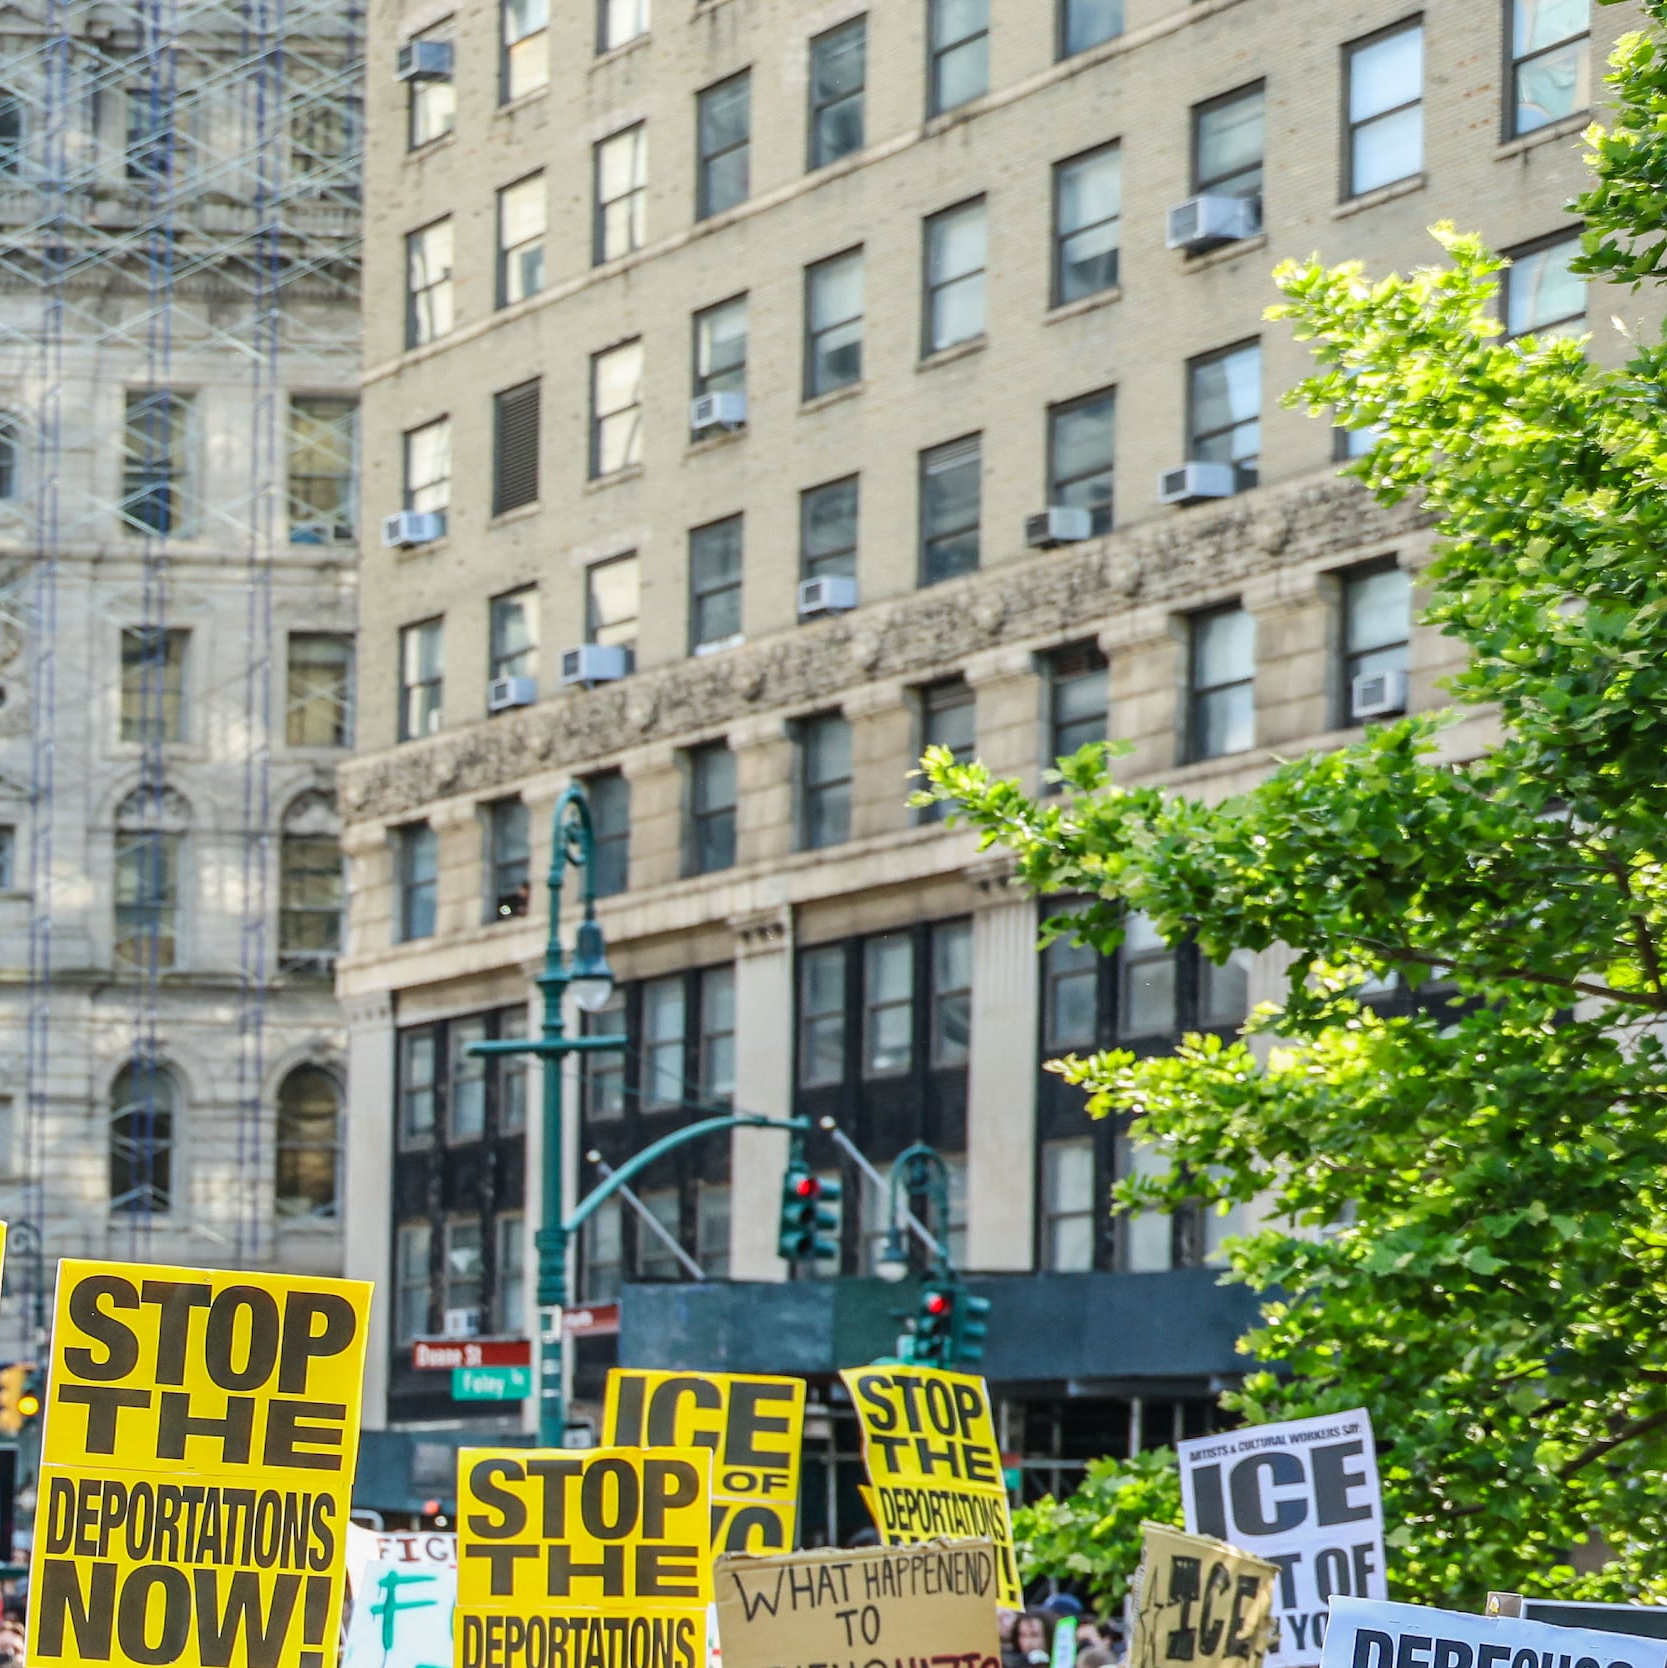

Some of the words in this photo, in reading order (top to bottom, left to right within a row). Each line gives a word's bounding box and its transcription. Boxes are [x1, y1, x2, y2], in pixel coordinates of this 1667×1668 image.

[64, 1275, 356, 1395] STOP
[418, 1343, 463, 1367] Duane
[57, 1383, 347, 1472] THE
[613, 1377, 796, 1468] ICE
[858, 1374, 984, 1439] STOP
[1289, 1426, 1340, 1446] WORKERS
[722, 1472, 789, 1494] OF
[870, 1437, 996, 1483] THE
[1192, 1440, 1373, 1541] ICE
[45, 1476, 335, 1572] DEPORTATIONS
[469, 1458, 699, 1541] STOP
[880, 1487, 1007, 1546] DEPORTATIONS
[465, 1544, 699, 1598] THE
[732, 1562, 853, 1623] WHAT
[1315, 1541, 1375, 1607] OF
[835, 1604, 881, 1647] TO
[1164, 1555, 1261, 1663] ICE
